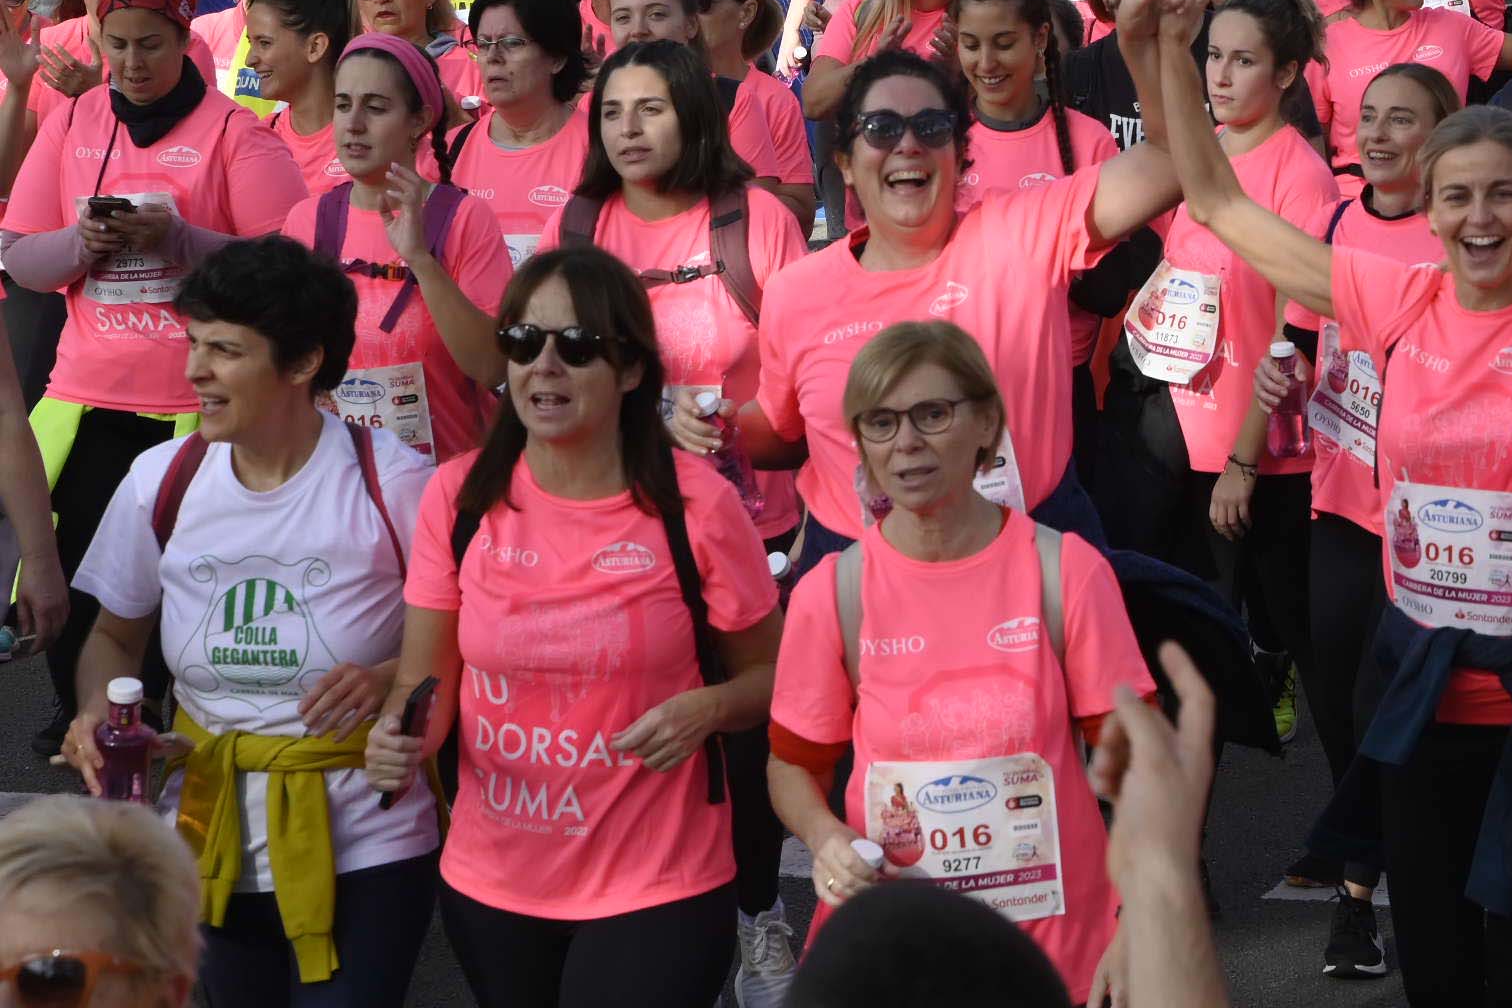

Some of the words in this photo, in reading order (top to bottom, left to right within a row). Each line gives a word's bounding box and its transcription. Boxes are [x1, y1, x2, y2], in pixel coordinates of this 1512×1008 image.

[95, 307, 180, 334] SUMA
[1156, 311, 1188, 331] 016
[1422, 509, 1479, 527] ASTURIANA
[1424, 542, 1475, 566] 016
[1429, 569, 1468, 585] 20799
[233, 624, 279, 647] COLLA
[210, 646, 301, 669] GEGANTERA
[467, 664, 509, 705] TU
[1003, 772, 1040, 787] SUMA
[922, 788, 992, 806] ASTURIANA
[930, 823, 993, 851] 016
[942, 856, 982, 873] 9277
[961, 877, 977, 887] LA
[978, 873, 1015, 886] MUJER
[991, 892, 1050, 910] Santander
